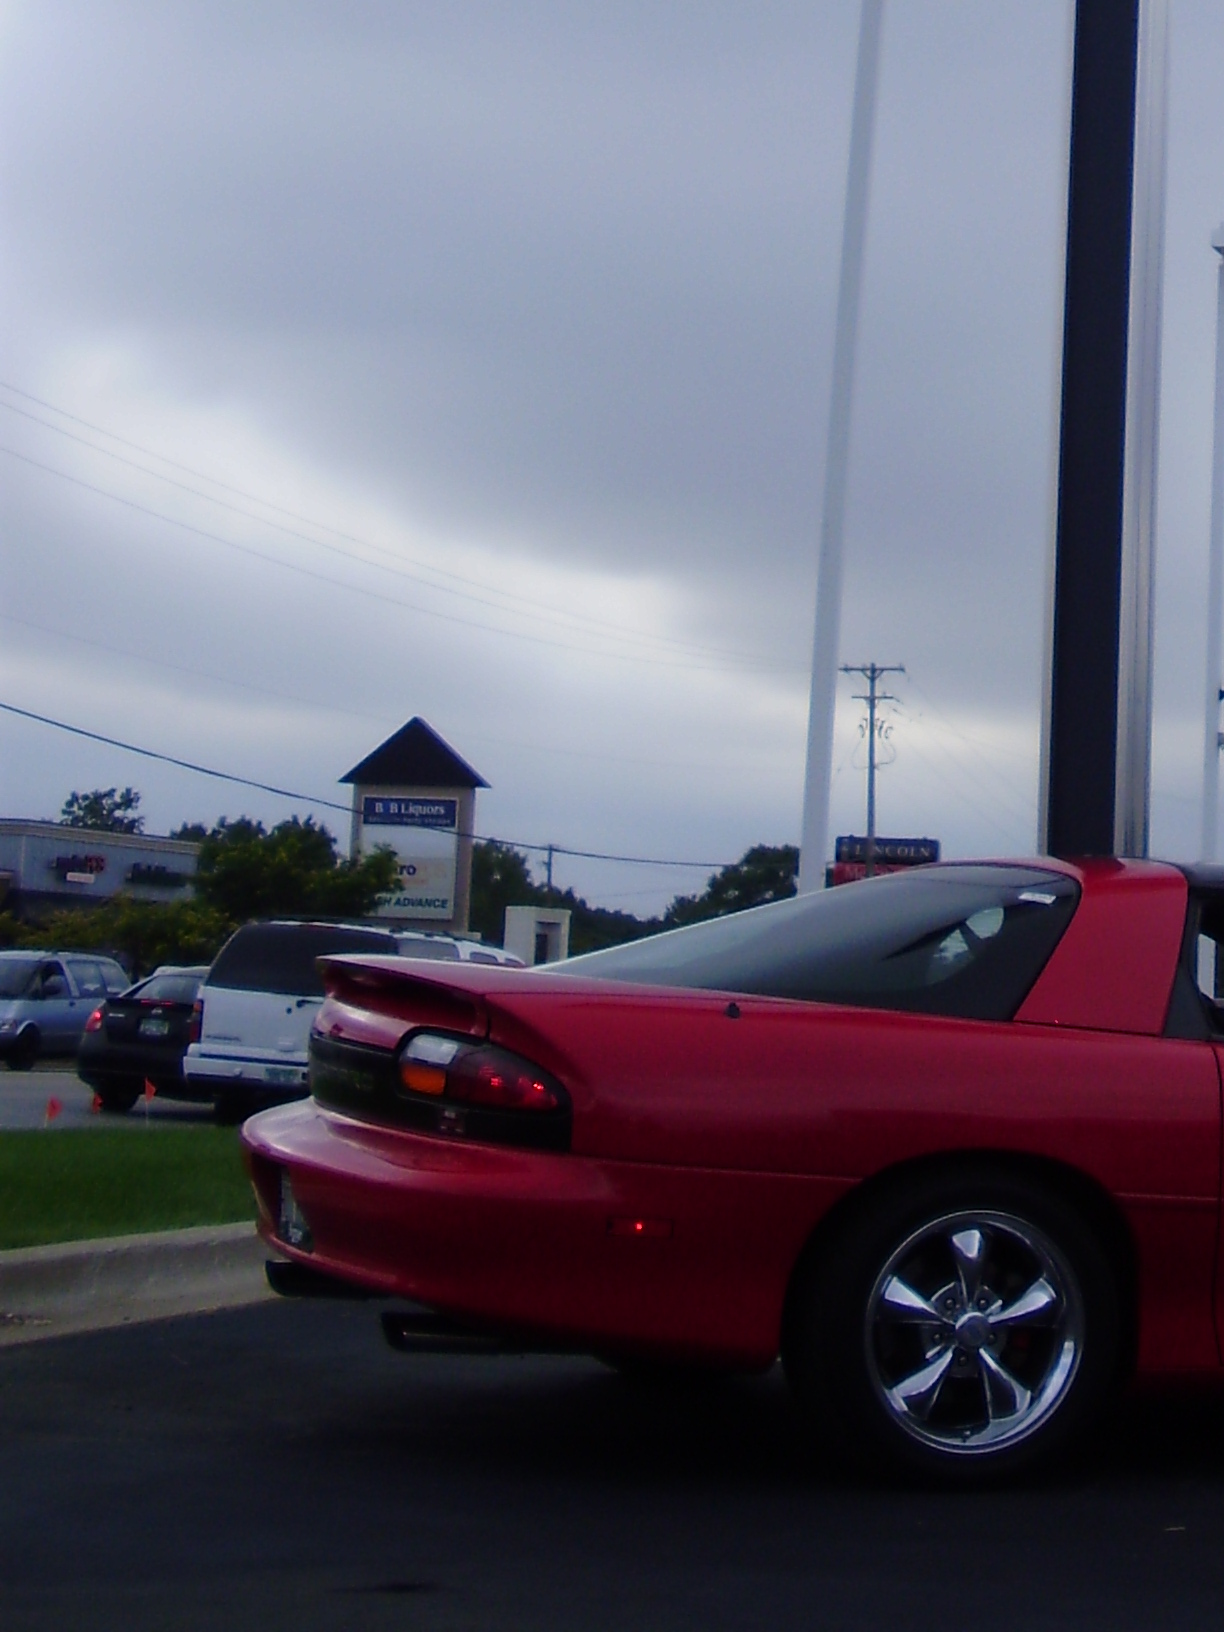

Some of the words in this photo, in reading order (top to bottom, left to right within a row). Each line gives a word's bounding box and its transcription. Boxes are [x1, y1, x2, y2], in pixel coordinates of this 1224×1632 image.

[401, 803, 445, 817] Liquors
[855, 844, 931, 857] LNCOLN
[394, 898, 448, 909] ADVANCE
